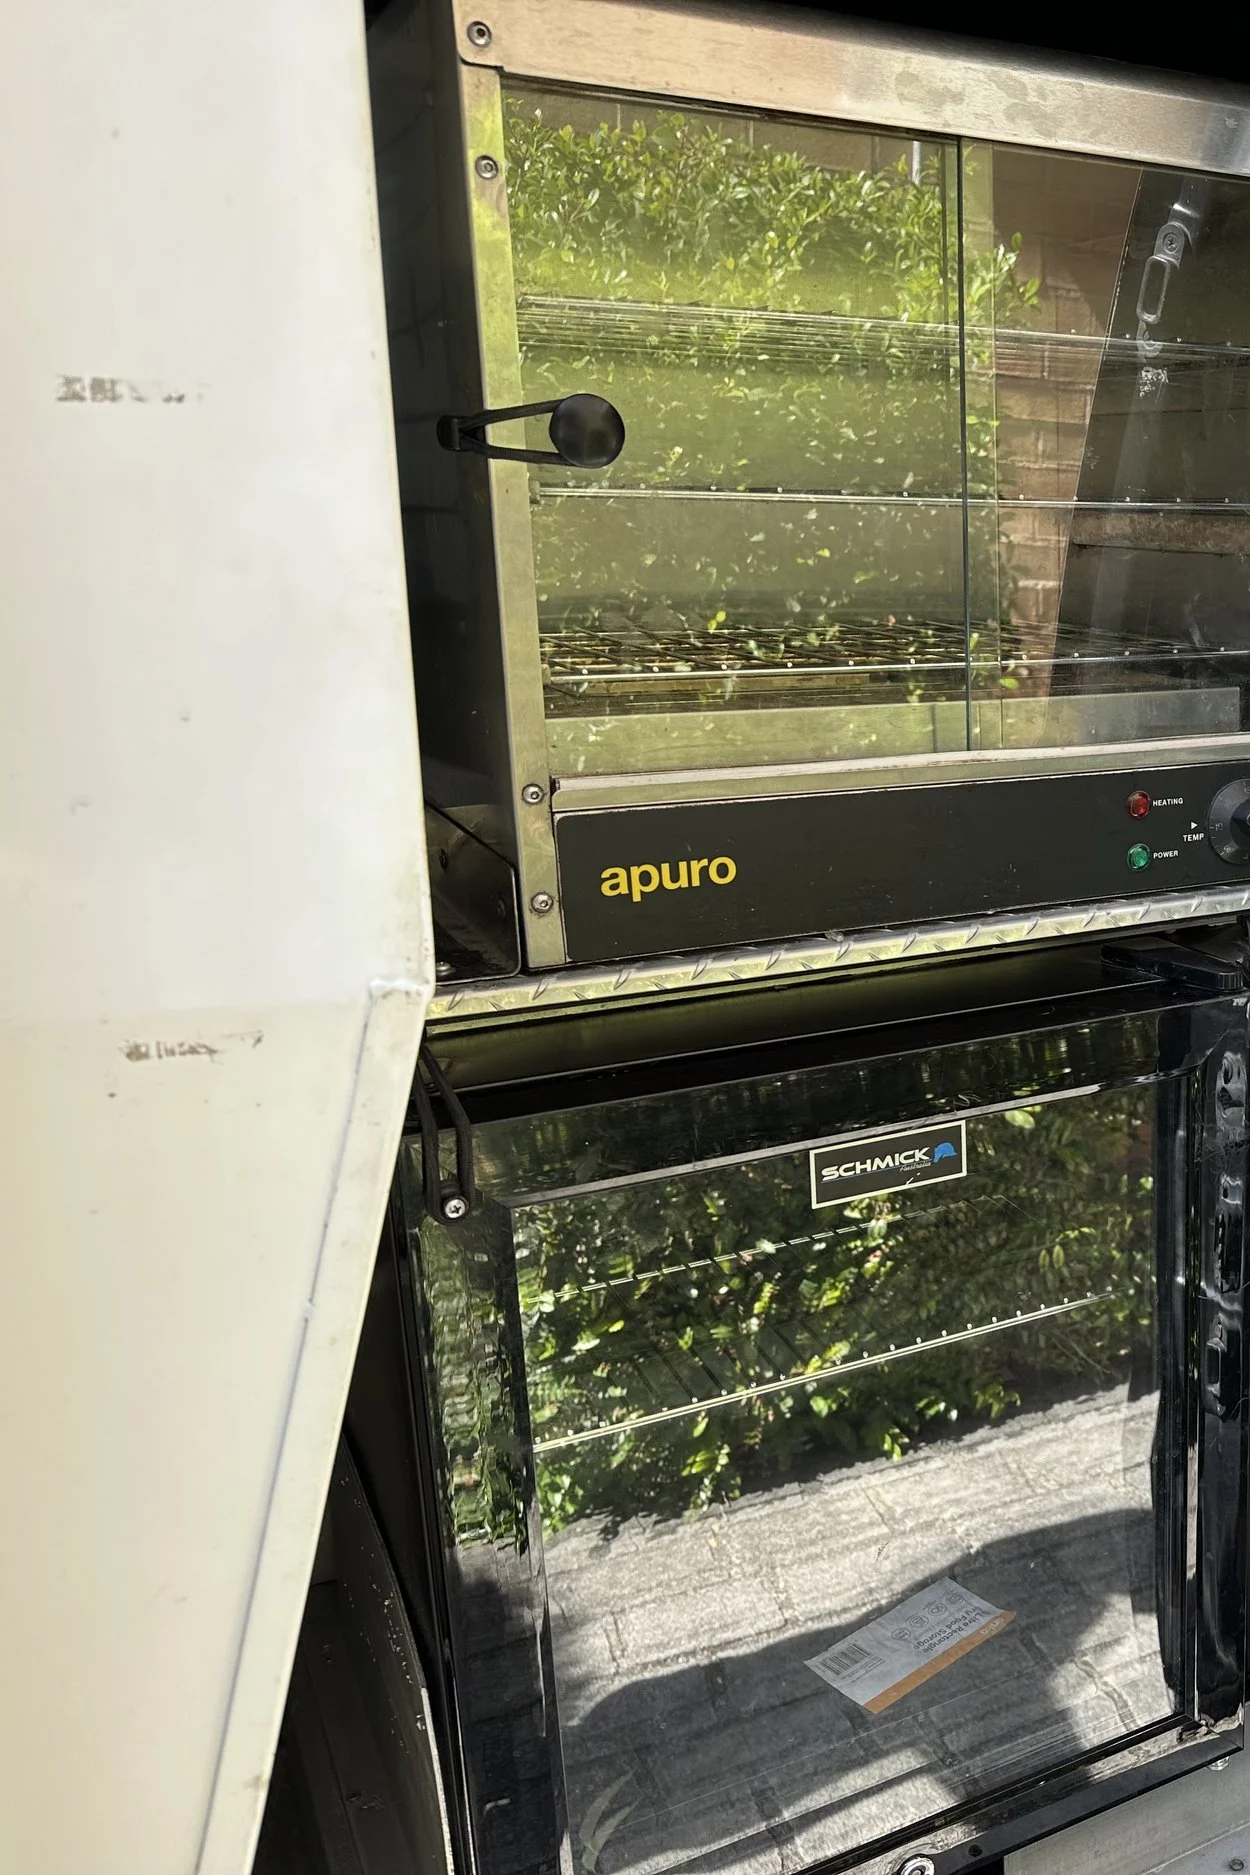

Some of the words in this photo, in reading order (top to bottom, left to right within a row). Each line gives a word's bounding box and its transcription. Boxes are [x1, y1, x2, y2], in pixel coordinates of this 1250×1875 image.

[1152, 797, 1184, 807] HEATING
[1183, 832, 1205, 842] TEMP
[1153, 850, 1179, 860] POWER
[601, 856, 737, 902] apuro
[821, 1146, 930, 1182] SCHMICK
[945, 1615, 968, 1629] Food
[980, 1617, 1004, 1634] anko
[913, 1627, 947, 1650] Storage
[922, 1625, 964, 1653] Rectangle
